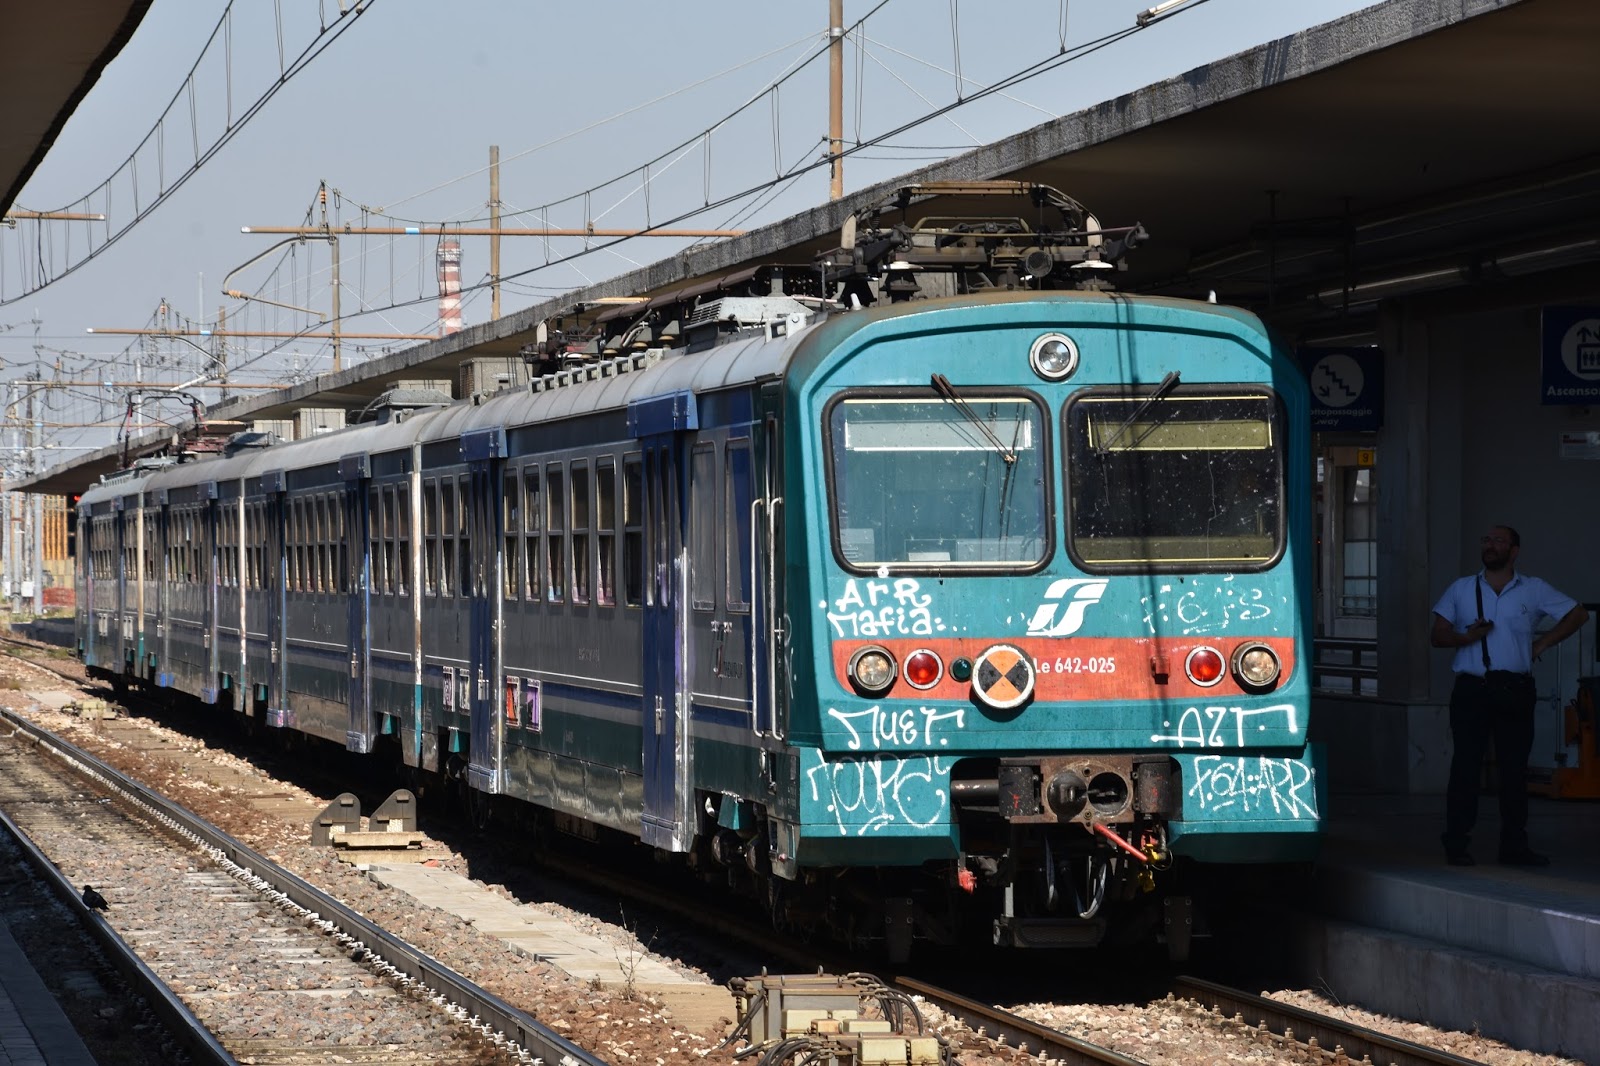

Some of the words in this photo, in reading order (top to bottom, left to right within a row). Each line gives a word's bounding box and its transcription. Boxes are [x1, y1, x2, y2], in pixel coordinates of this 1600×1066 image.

[1547, 385, 1600, 397] Ascenso
[1362, 452, 1370, 463] 9
[1054, 657, 1116, 674] 642-025
